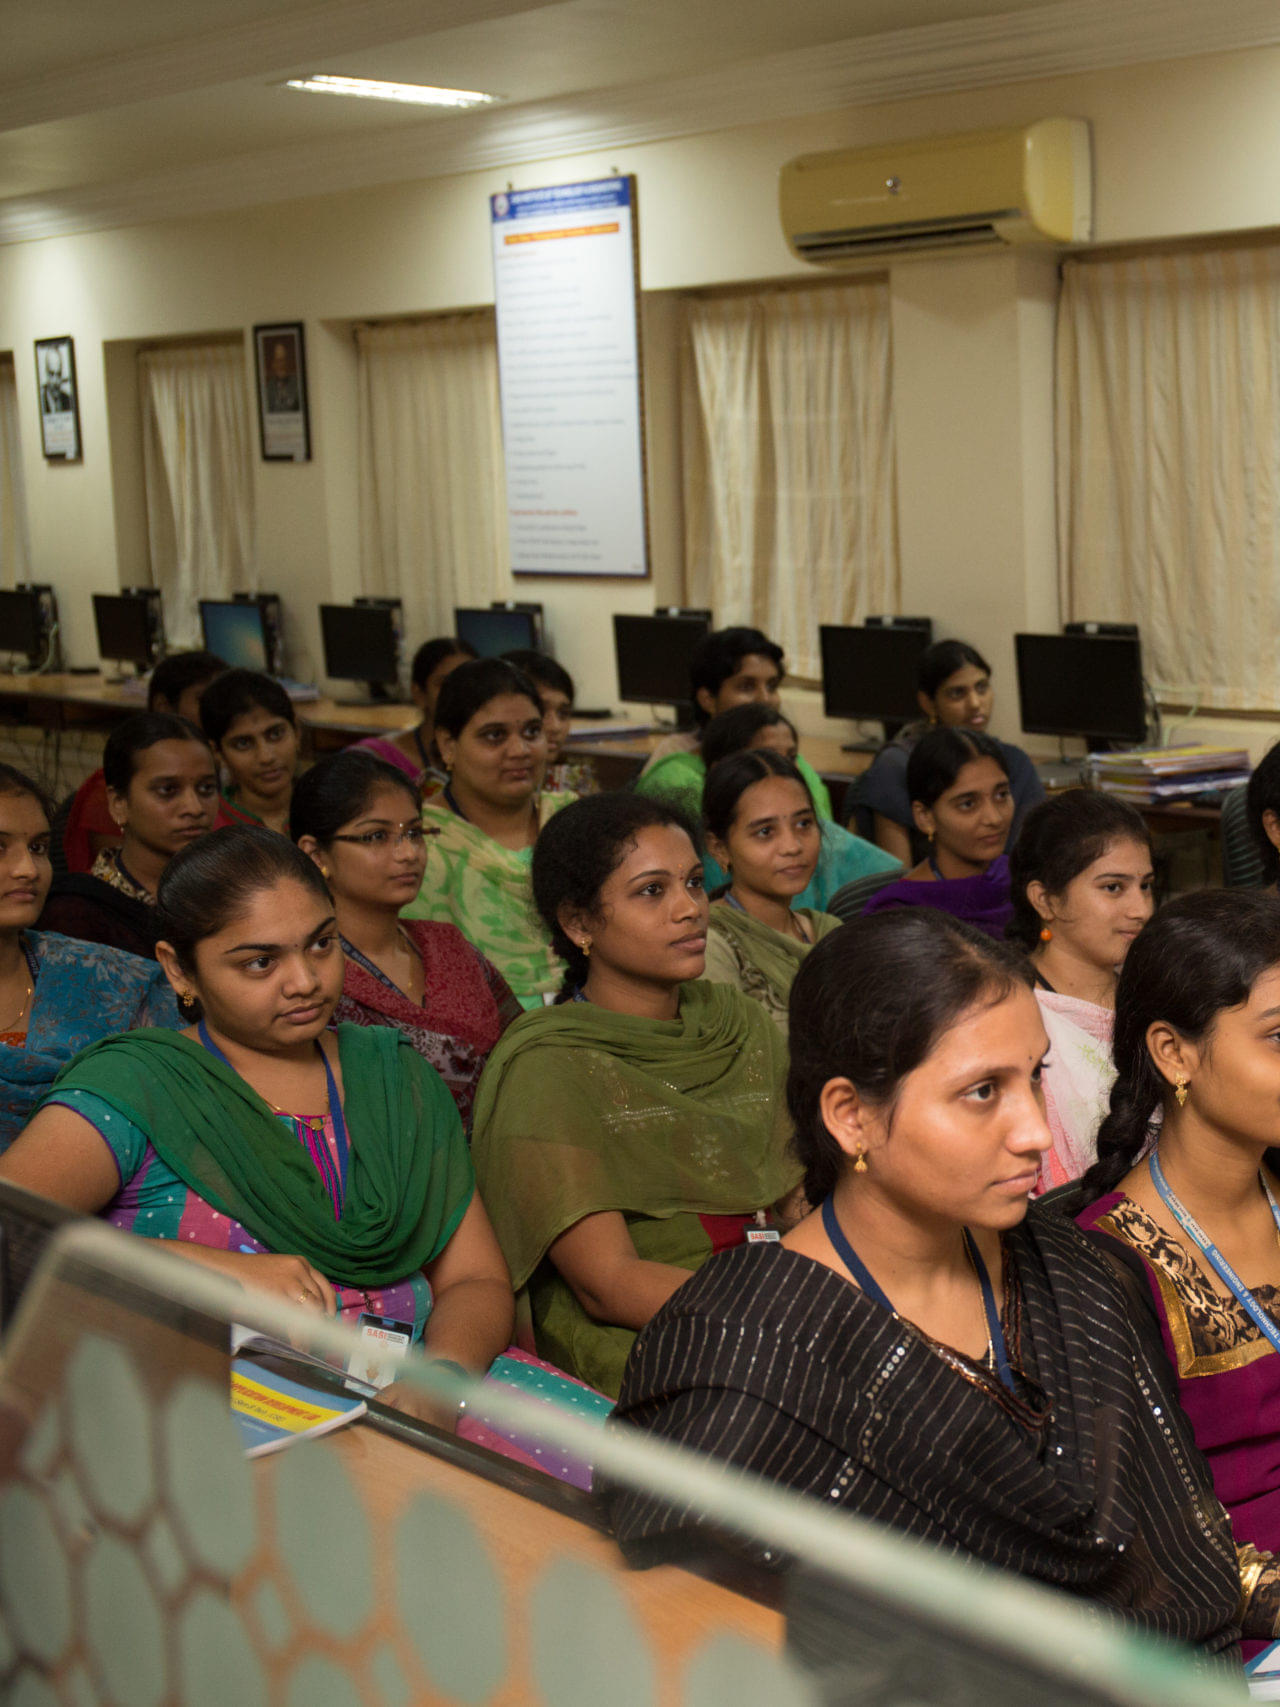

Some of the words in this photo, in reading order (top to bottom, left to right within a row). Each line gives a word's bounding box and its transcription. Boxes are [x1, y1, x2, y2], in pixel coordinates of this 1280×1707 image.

[750, 1232, 765, 1240] SASI
[1209, 1248, 1245, 1292] ENGINEERING
[1241, 1290, 1249, 1298] &
[1245, 1295, 1280, 1339] TECHNOLOGY
[367, 1328, 388, 1340] SASI
